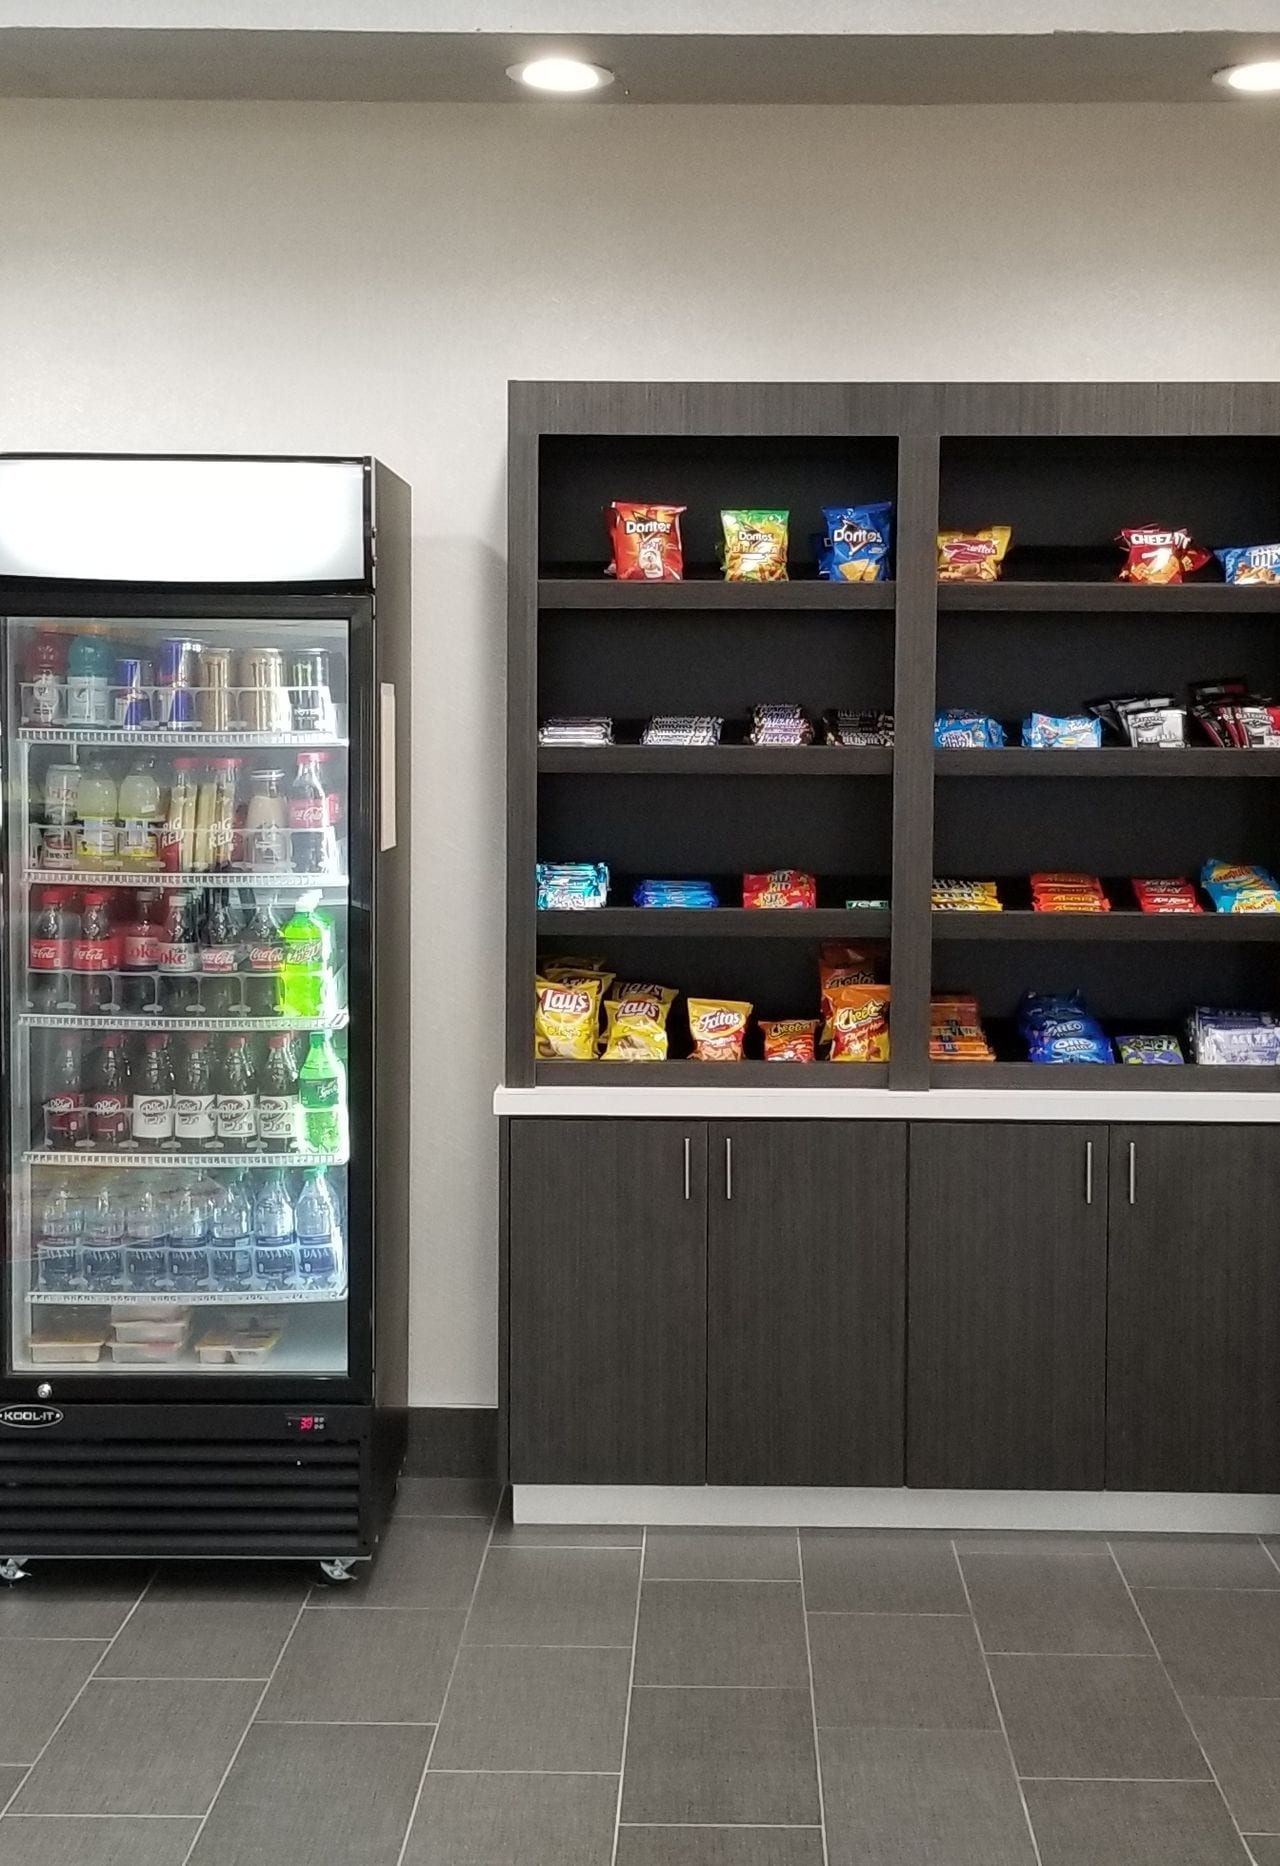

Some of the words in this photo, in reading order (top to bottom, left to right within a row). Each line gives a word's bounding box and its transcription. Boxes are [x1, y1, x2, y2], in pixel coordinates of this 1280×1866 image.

[626, 521, 671, 534] Doritos
[738, 530, 773, 541] Doritos
[833, 529, 883, 543] Doritos
[543, 989, 588, 1014] Lay's
[699, 1011, 741, 1031] Fritos
[3, 1411, 55, 1422] KOOL-IT
